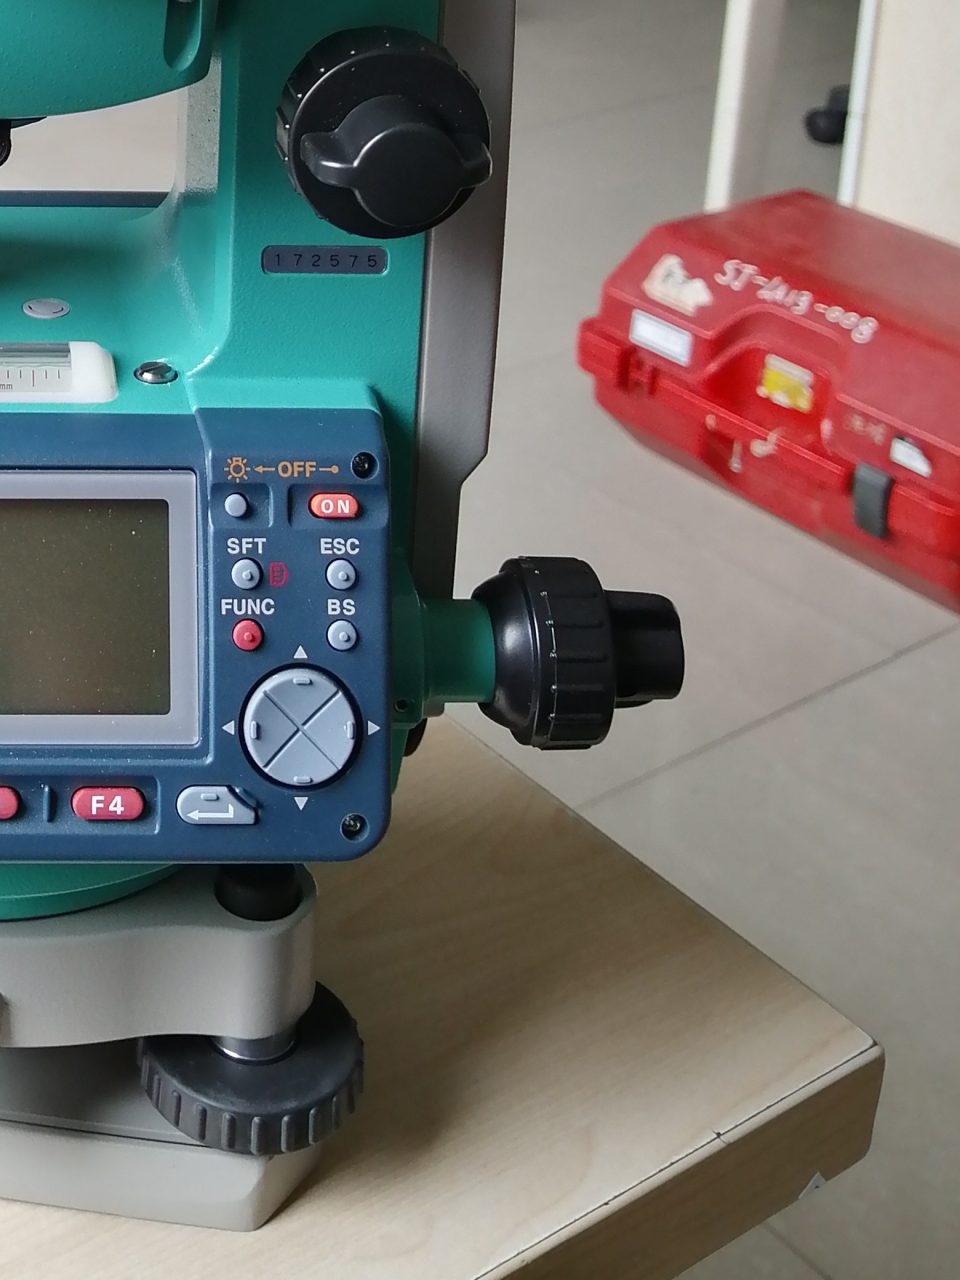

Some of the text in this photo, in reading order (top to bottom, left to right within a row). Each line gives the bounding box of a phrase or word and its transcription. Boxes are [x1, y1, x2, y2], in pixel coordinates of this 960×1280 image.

[275, 254, 377, 268] 172575
[277, 461, 317, 478] OFF
[321, 499, 350, 513] ON
[227, 538, 267, 555] SFT
[320, 538, 360, 555] ESC
[221, 598, 275, 615] FUNC
[327, 599, 356, 615] BS
[91, 795, 125, 814] F4
